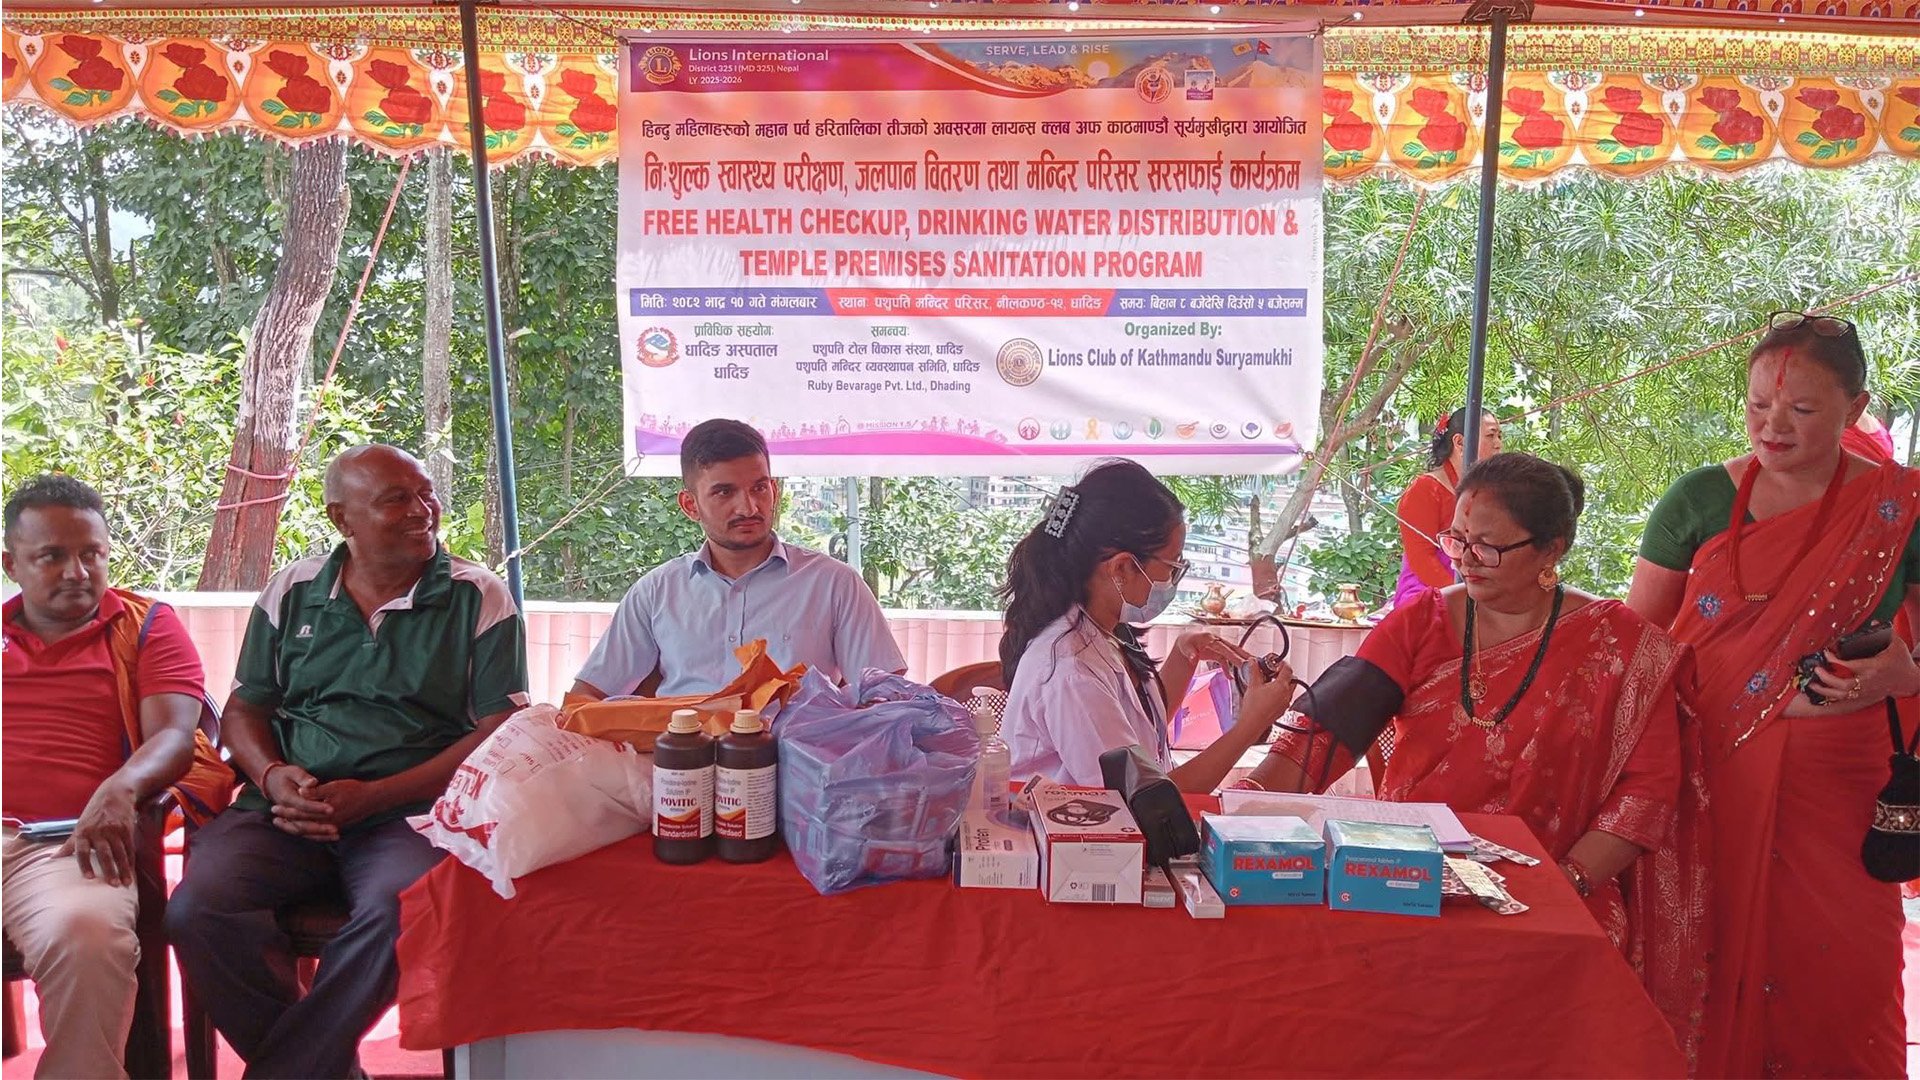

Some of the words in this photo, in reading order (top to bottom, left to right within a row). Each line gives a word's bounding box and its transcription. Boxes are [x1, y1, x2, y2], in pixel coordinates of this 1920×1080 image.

[689, 49, 728, 61] Lions
[732, 49, 829, 61] International
[986, 45, 1030, 57] SERVE,
[1033, 45, 1067, 55] LEAD
[1070, 45, 1078, 55] &
[1081, 44, 1110, 54] RISE
[688, 65, 717, 73] District
[718, 65, 732, 73] 325
[738, 65, 755, 74] (MD
[777, 65, 800, 75] Nepal
[701, 76, 742, 84] 2025-2026
[642, 118, 671, 140] हिन्दु
[755, 122, 788, 138] महान
[794, 119, 810, 136] पर्व
[815, 118, 882, 137] हरितालिका
[887, 118, 929, 137] तीजको
[933, 121, 987, 137] अवसरमा
[991, 121, 1037, 137] लायन्स
[1041, 121, 1070, 136] क्लब
[1076, 121, 1101, 135] अफ
[1252, 117, 1307, 135] आयोजित
[717, 160, 777, 192] स्वास्थ्य
[784, 152, 849, 197] परीक्षण,
[855, 161, 918, 192] जलपान
[924, 150, 982, 193] वितरण
[987, 160, 1020, 192] तथा
[1026, 149, 1080, 193] मन्दिर
[1086, 149, 1141, 192] परिसर
[1147, 150, 1224, 196] सरसफाई
[1230, 150, 1301, 193] कार्यक्रम
[643, 209, 698, 235] FREE
[705, 208, 793, 234] HEALTH
[800, 208, 911, 240] CHECKUP,
[917, 208, 1028, 235] DRINKING
[1034, 209, 1112, 235] WATER
[1118, 209, 1276, 236] DISTRIBUTION
[1283, 209, 1299, 236] &
[739, 250, 828, 276] TEMPLE
[835, 250, 947, 276] PREMISES
[953, 251, 1086, 277] SANITATION
[1093, 251, 1203, 277] PROGRAM
[672, 297, 701, 308] २०८२
[705, 296, 726, 310] भाद्र
[730, 297, 744, 308] १०
[749, 294, 767, 309] गते
[874, 294, 911, 311] पशुपति
[915, 294, 949, 310] मन्दिर
[1070, 294, 1103, 309] धादिङ
[1180, 297, 1186, 308] ८
[1124, 322, 1195, 338] Organized
[1200, 322, 1222, 338] By:
[685, 340, 721, 357] धादिङ
[725, 344, 778, 358] अस्पताल
[812, 341, 845, 358] पशुपति
[848, 341, 868, 355] टोल
[936, 342, 964, 355] धादिङ
[796, 359, 828, 375] पशुपति
[831, 359, 863, 373] मन्दिर
[952, 359, 981, 373] धादिङ
[1048, 349, 1083, 366] Lions
[1087, 348, 1116, 366] Club
[1120, 348, 1133, 366] of
[1137, 348, 1212, 366] Kathmandu
[1216, 348, 1292, 370] Suryamukhi
[714, 363, 750, 379] धादिङ
[807, 380, 833, 392] Ruby
[836, 380, 882, 393] Bevarage
[885, 380, 904, 391] Pvt.
[930, 379, 971, 393] Dhading
[660, 797, 698, 807] POVITIC
[1233, 856, 1316, 871] REXAMOL
[1344, 862, 1432, 882] REXAMOL
